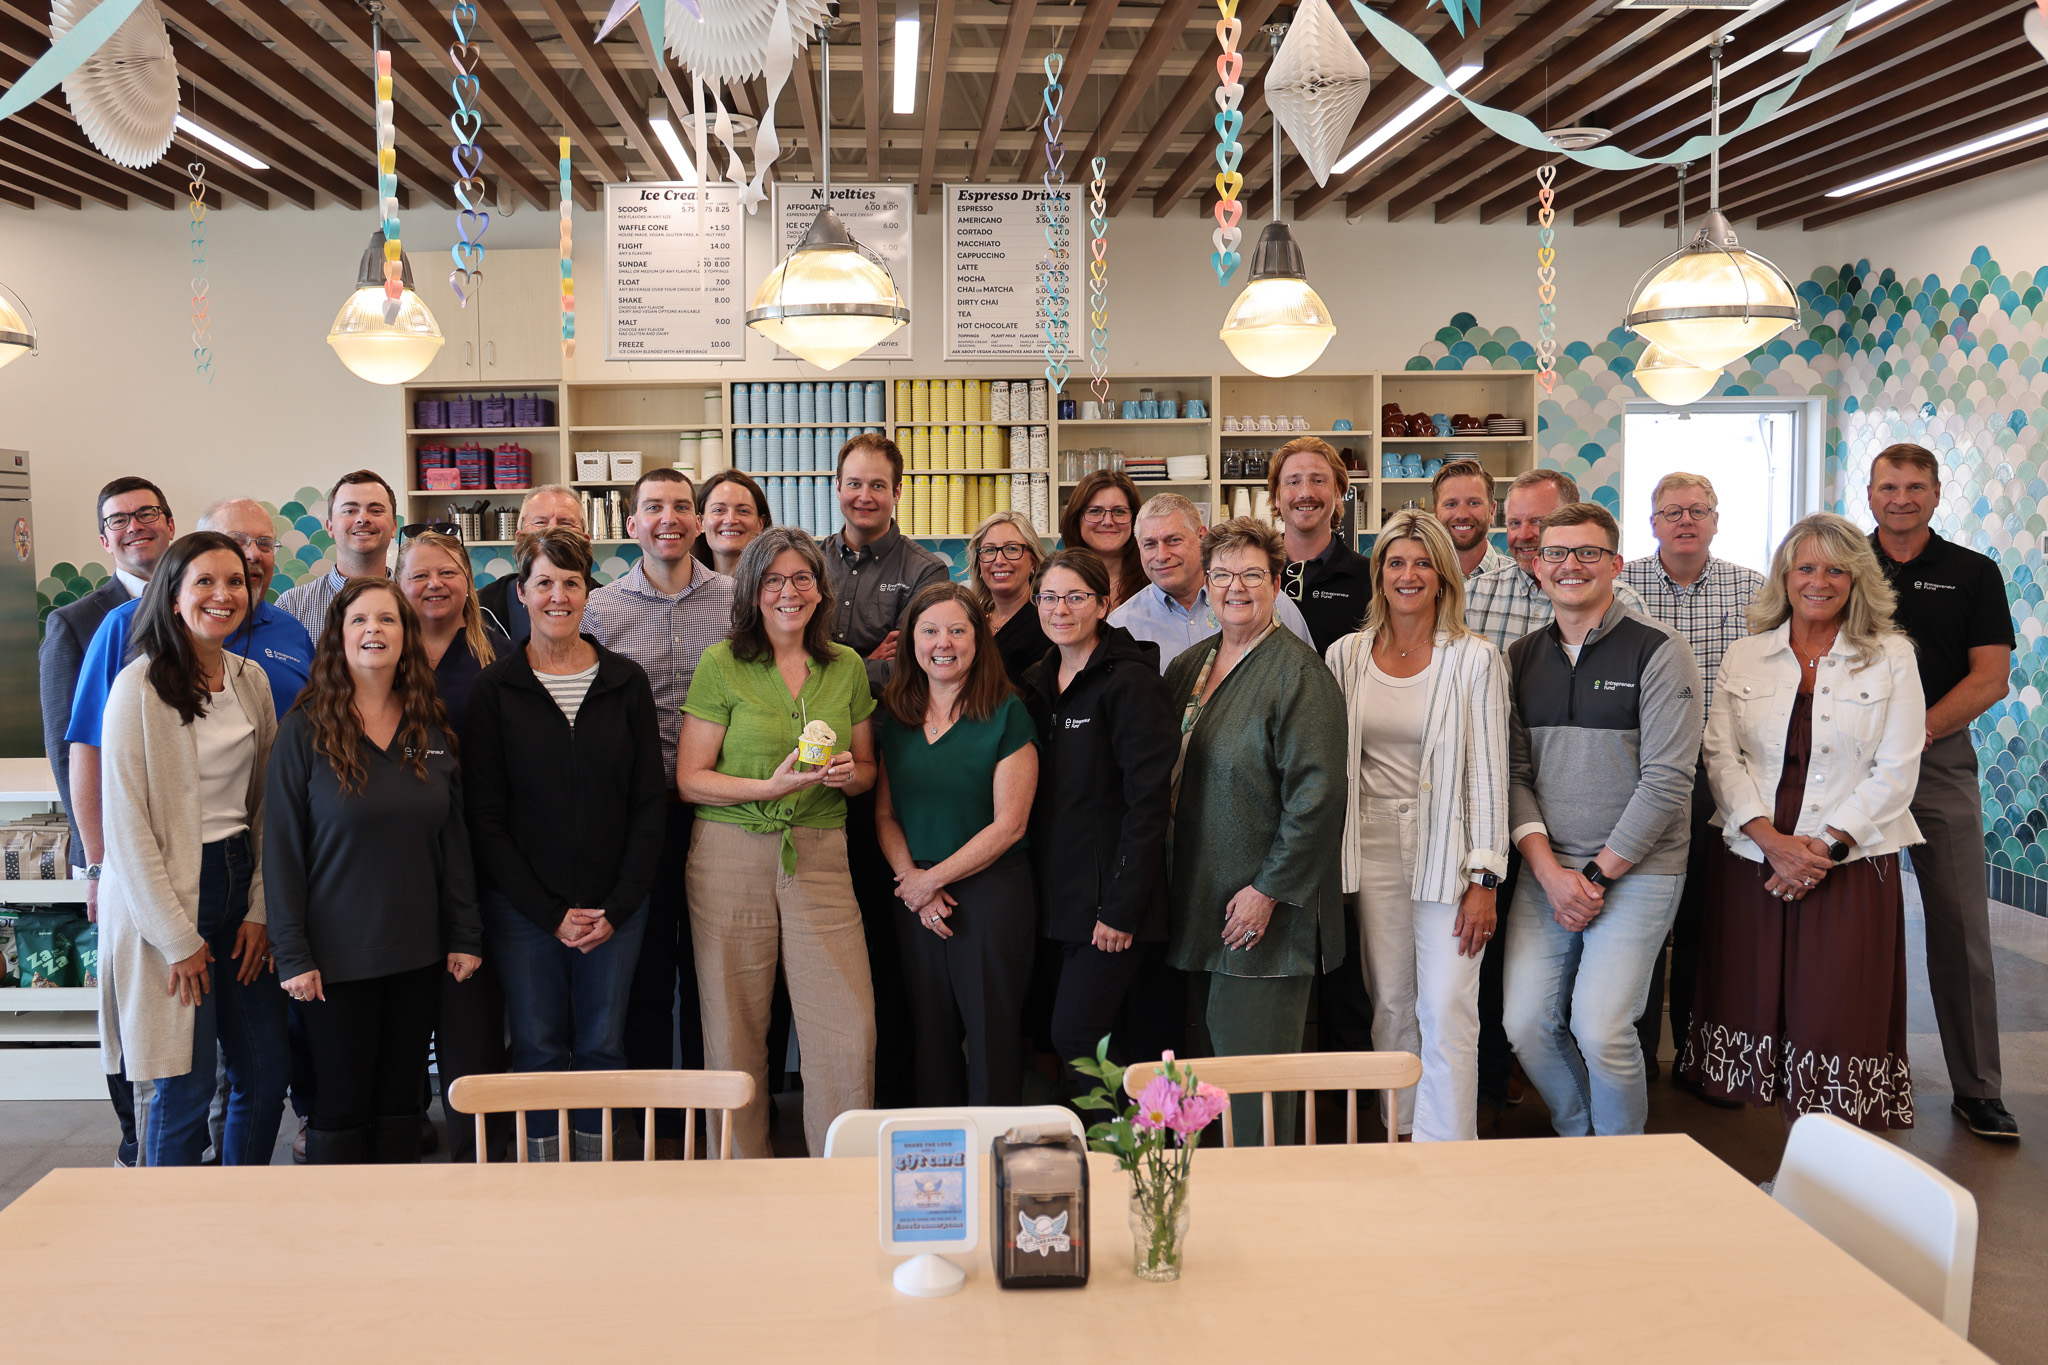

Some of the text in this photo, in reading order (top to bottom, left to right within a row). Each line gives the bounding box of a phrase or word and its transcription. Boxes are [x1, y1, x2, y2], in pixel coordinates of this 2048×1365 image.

[640, 190, 710, 200] Ice Crea
[811, 188, 876, 199] Nvelties
[958, 190, 1018, 203] Espresso
[274, 651, 300, 663] Entrepreneur
[802, 750, 826, 760] LOVE
[896, 1152, 965, 1171] gift card
